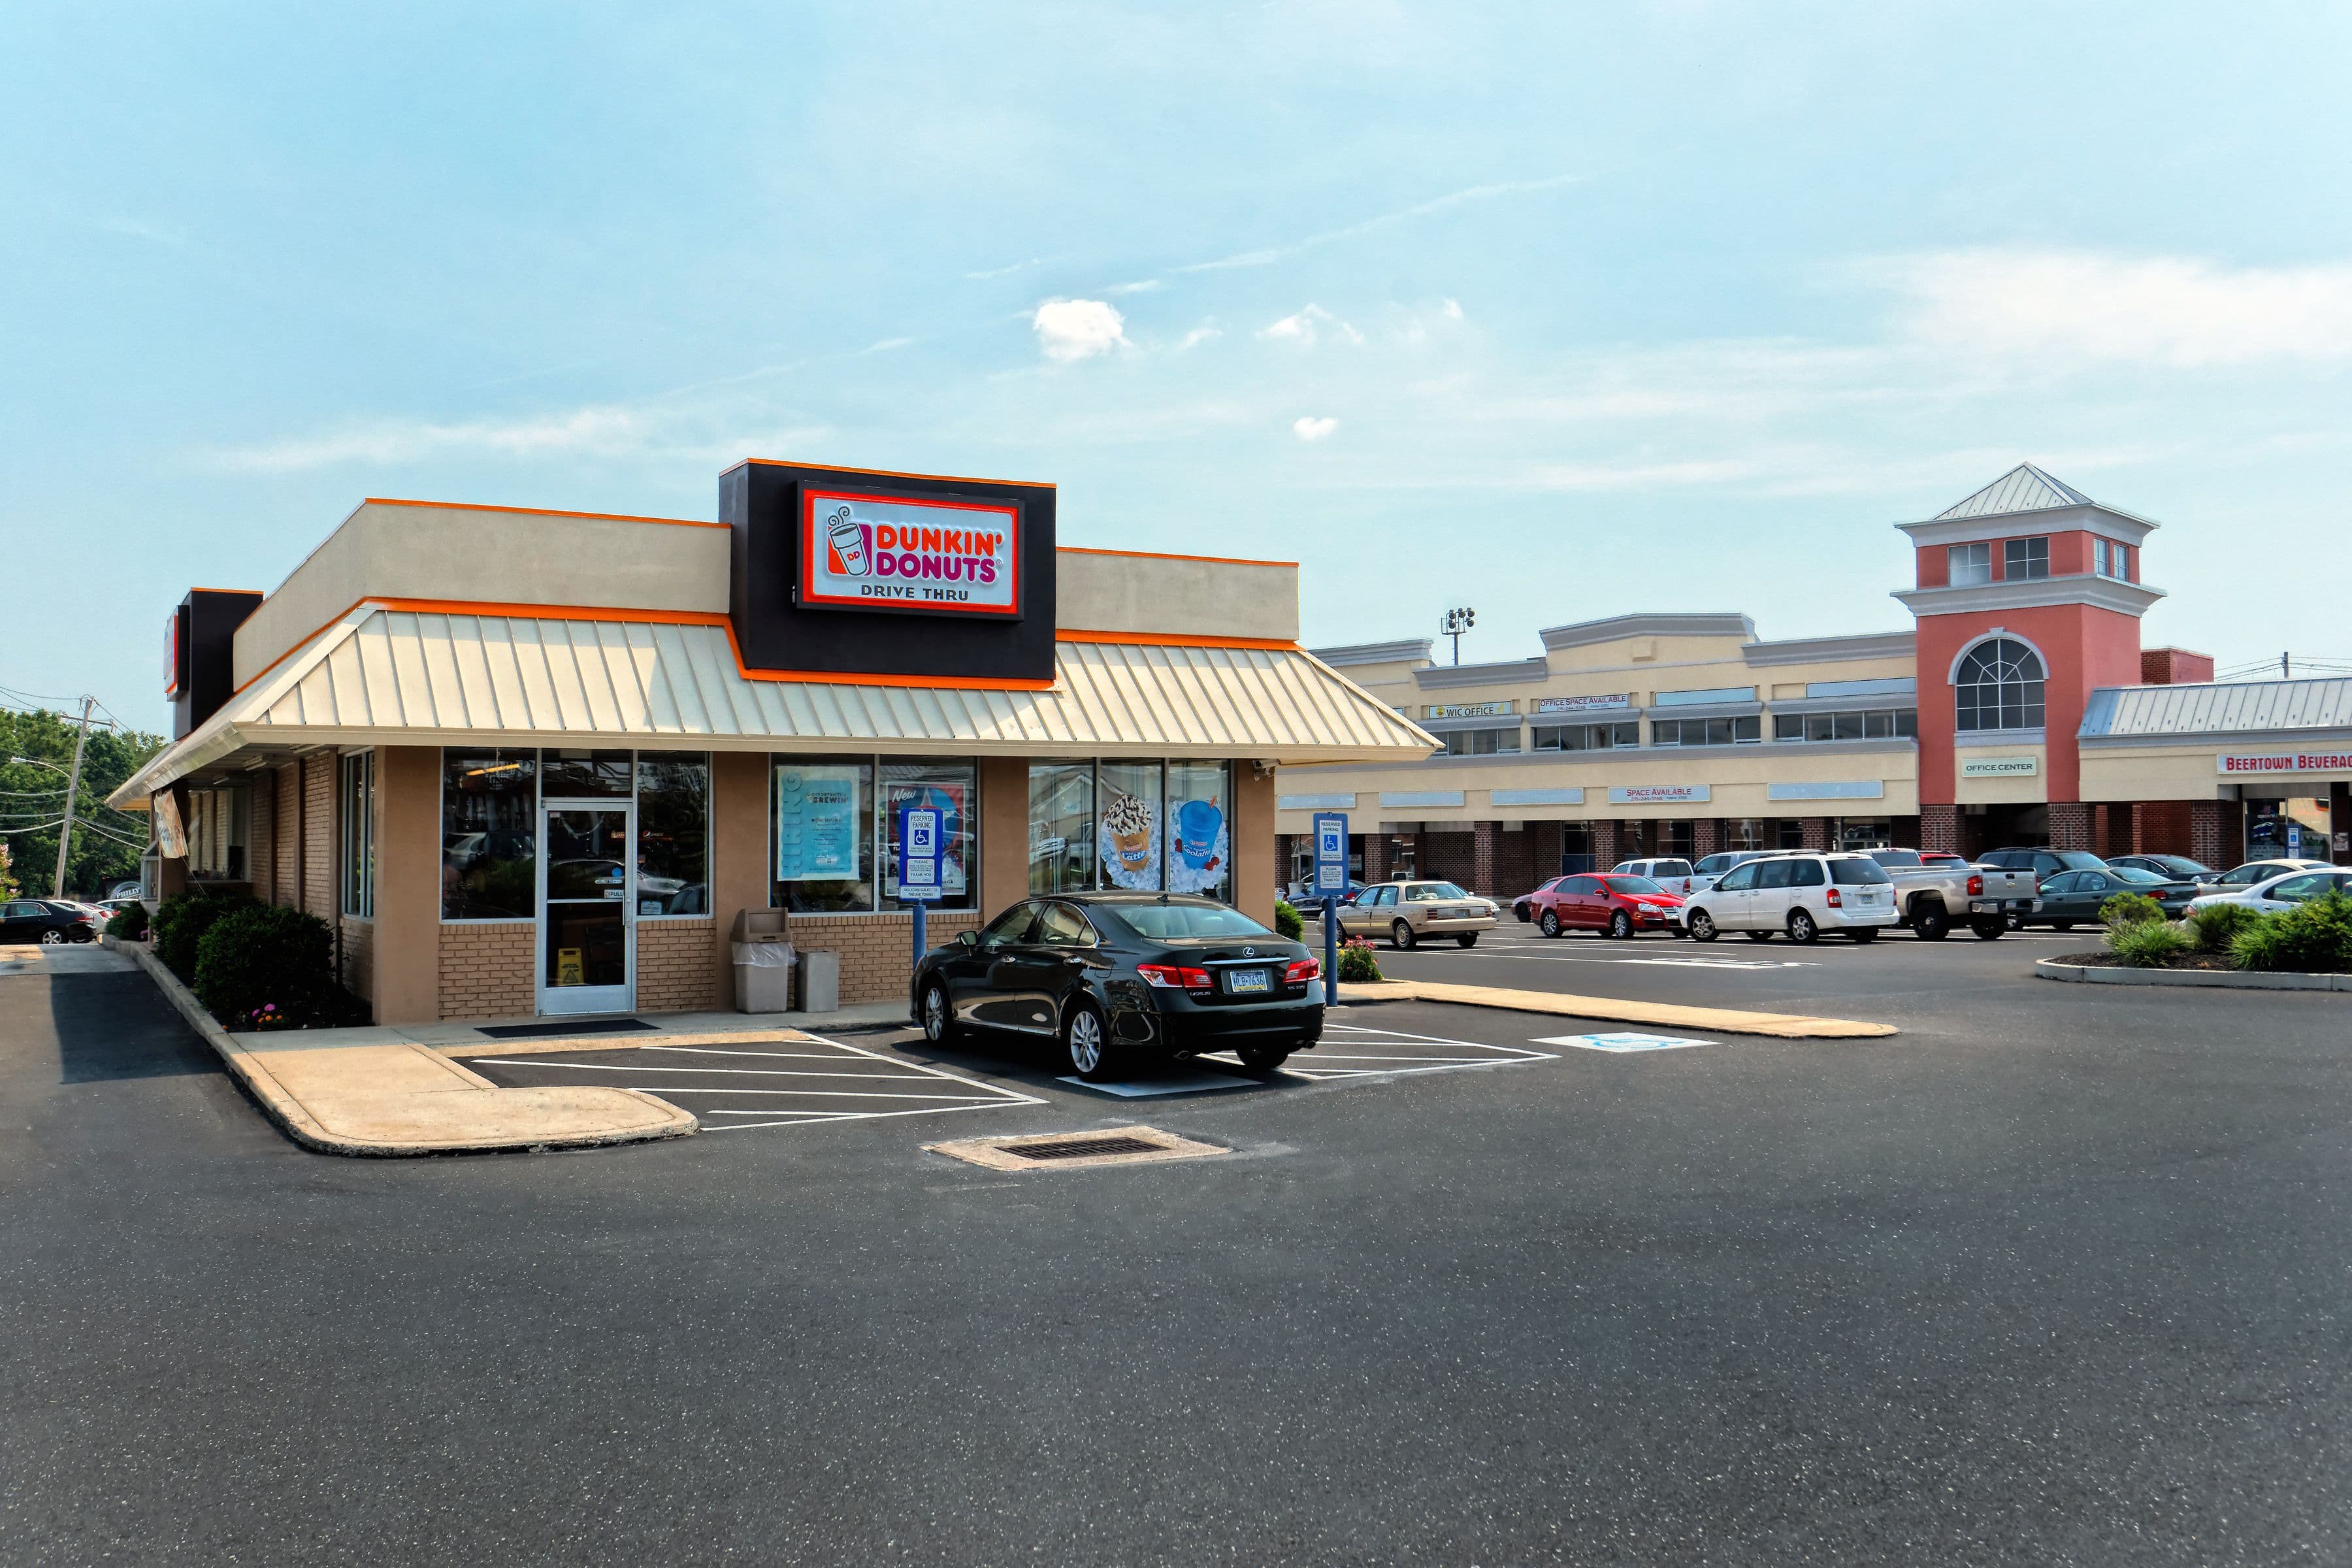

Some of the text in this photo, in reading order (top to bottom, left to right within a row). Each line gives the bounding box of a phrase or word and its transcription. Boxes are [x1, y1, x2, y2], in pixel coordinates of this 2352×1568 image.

[877, 525, 1002, 557] DUNKIN'
[847, 551, 860, 561] DD
[876, 551, 996, 583] DONUTS
[861, 585, 968, 601] DRIVE THRU
[1589, 695, 1626, 704] AVAILABLE
[1446, 707, 1494, 717] WIC OFFICE
[2226, 756, 2293, 771] BEERTOWN
[892, 788, 916, 802] New
[116, 888, 140, 898] PHILLY
